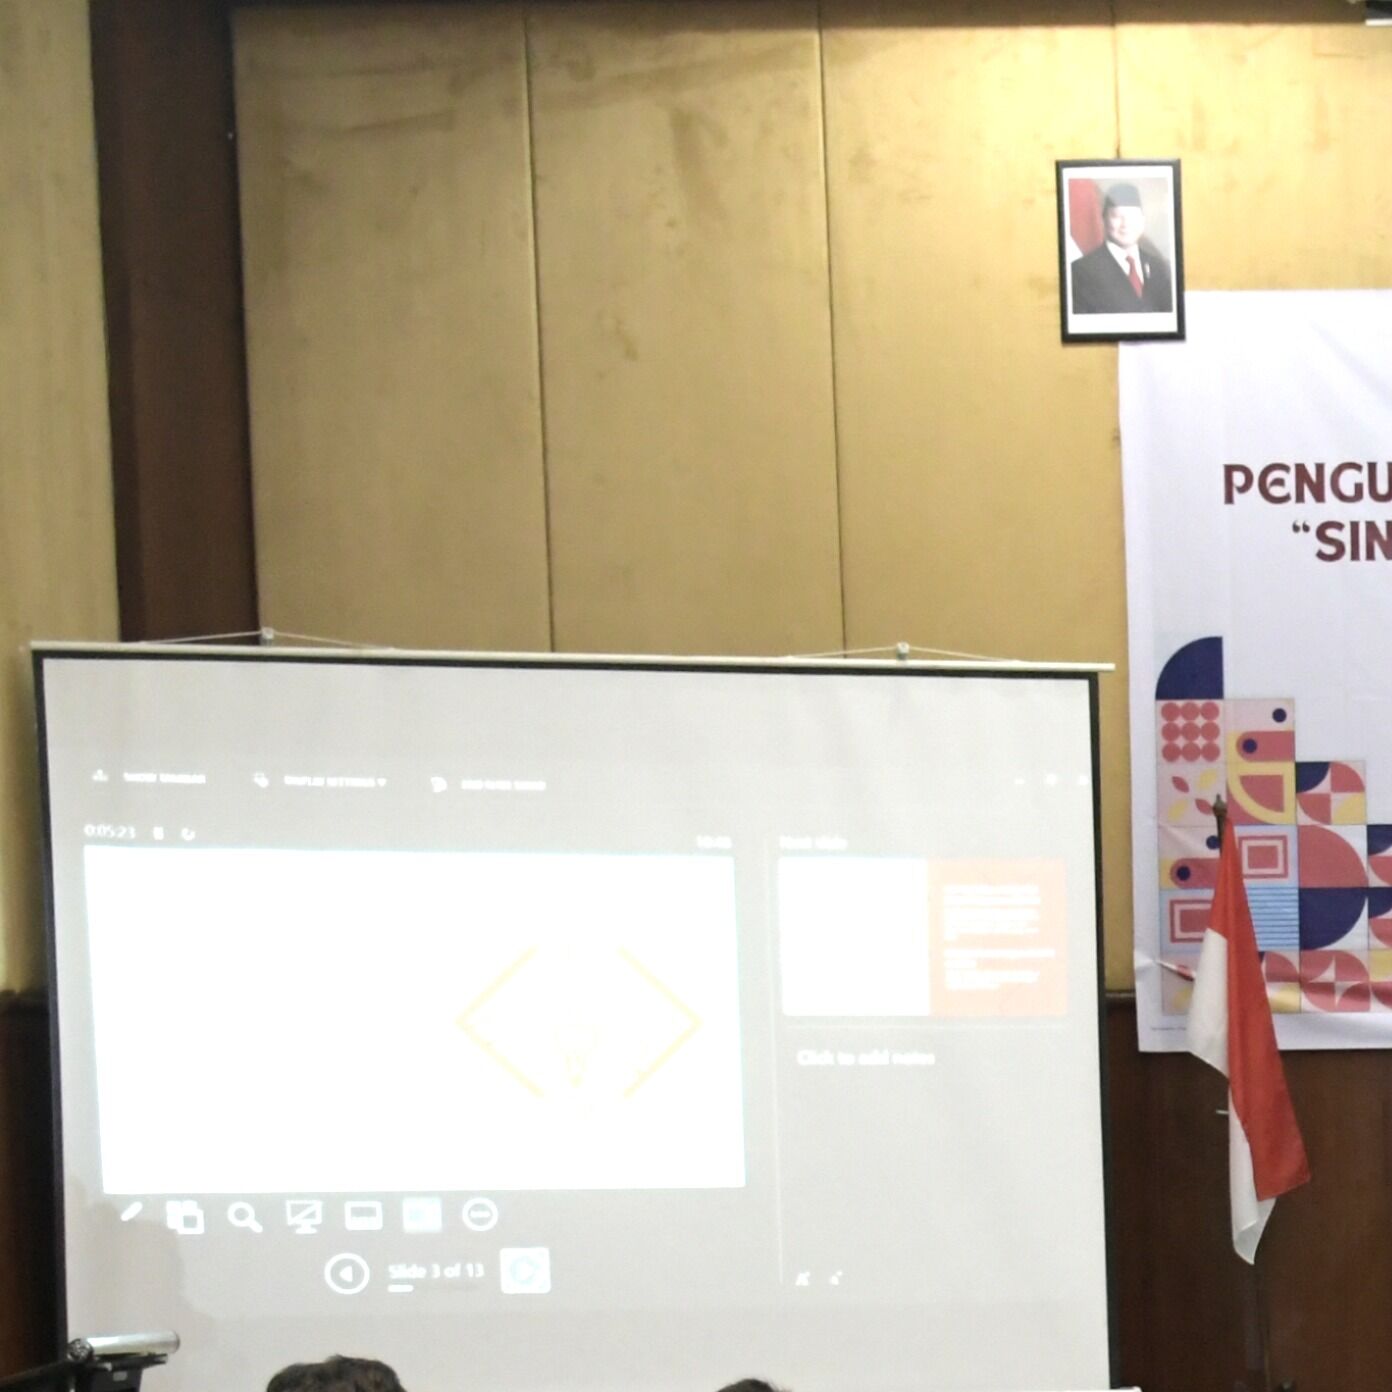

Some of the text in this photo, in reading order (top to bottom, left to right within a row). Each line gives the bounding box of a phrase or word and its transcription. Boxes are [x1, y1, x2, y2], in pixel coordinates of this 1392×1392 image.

[388, 1262, 427, 1278] Slide
[444, 1261, 462, 1277] of
[466, 1262, 485, 1277] 13
